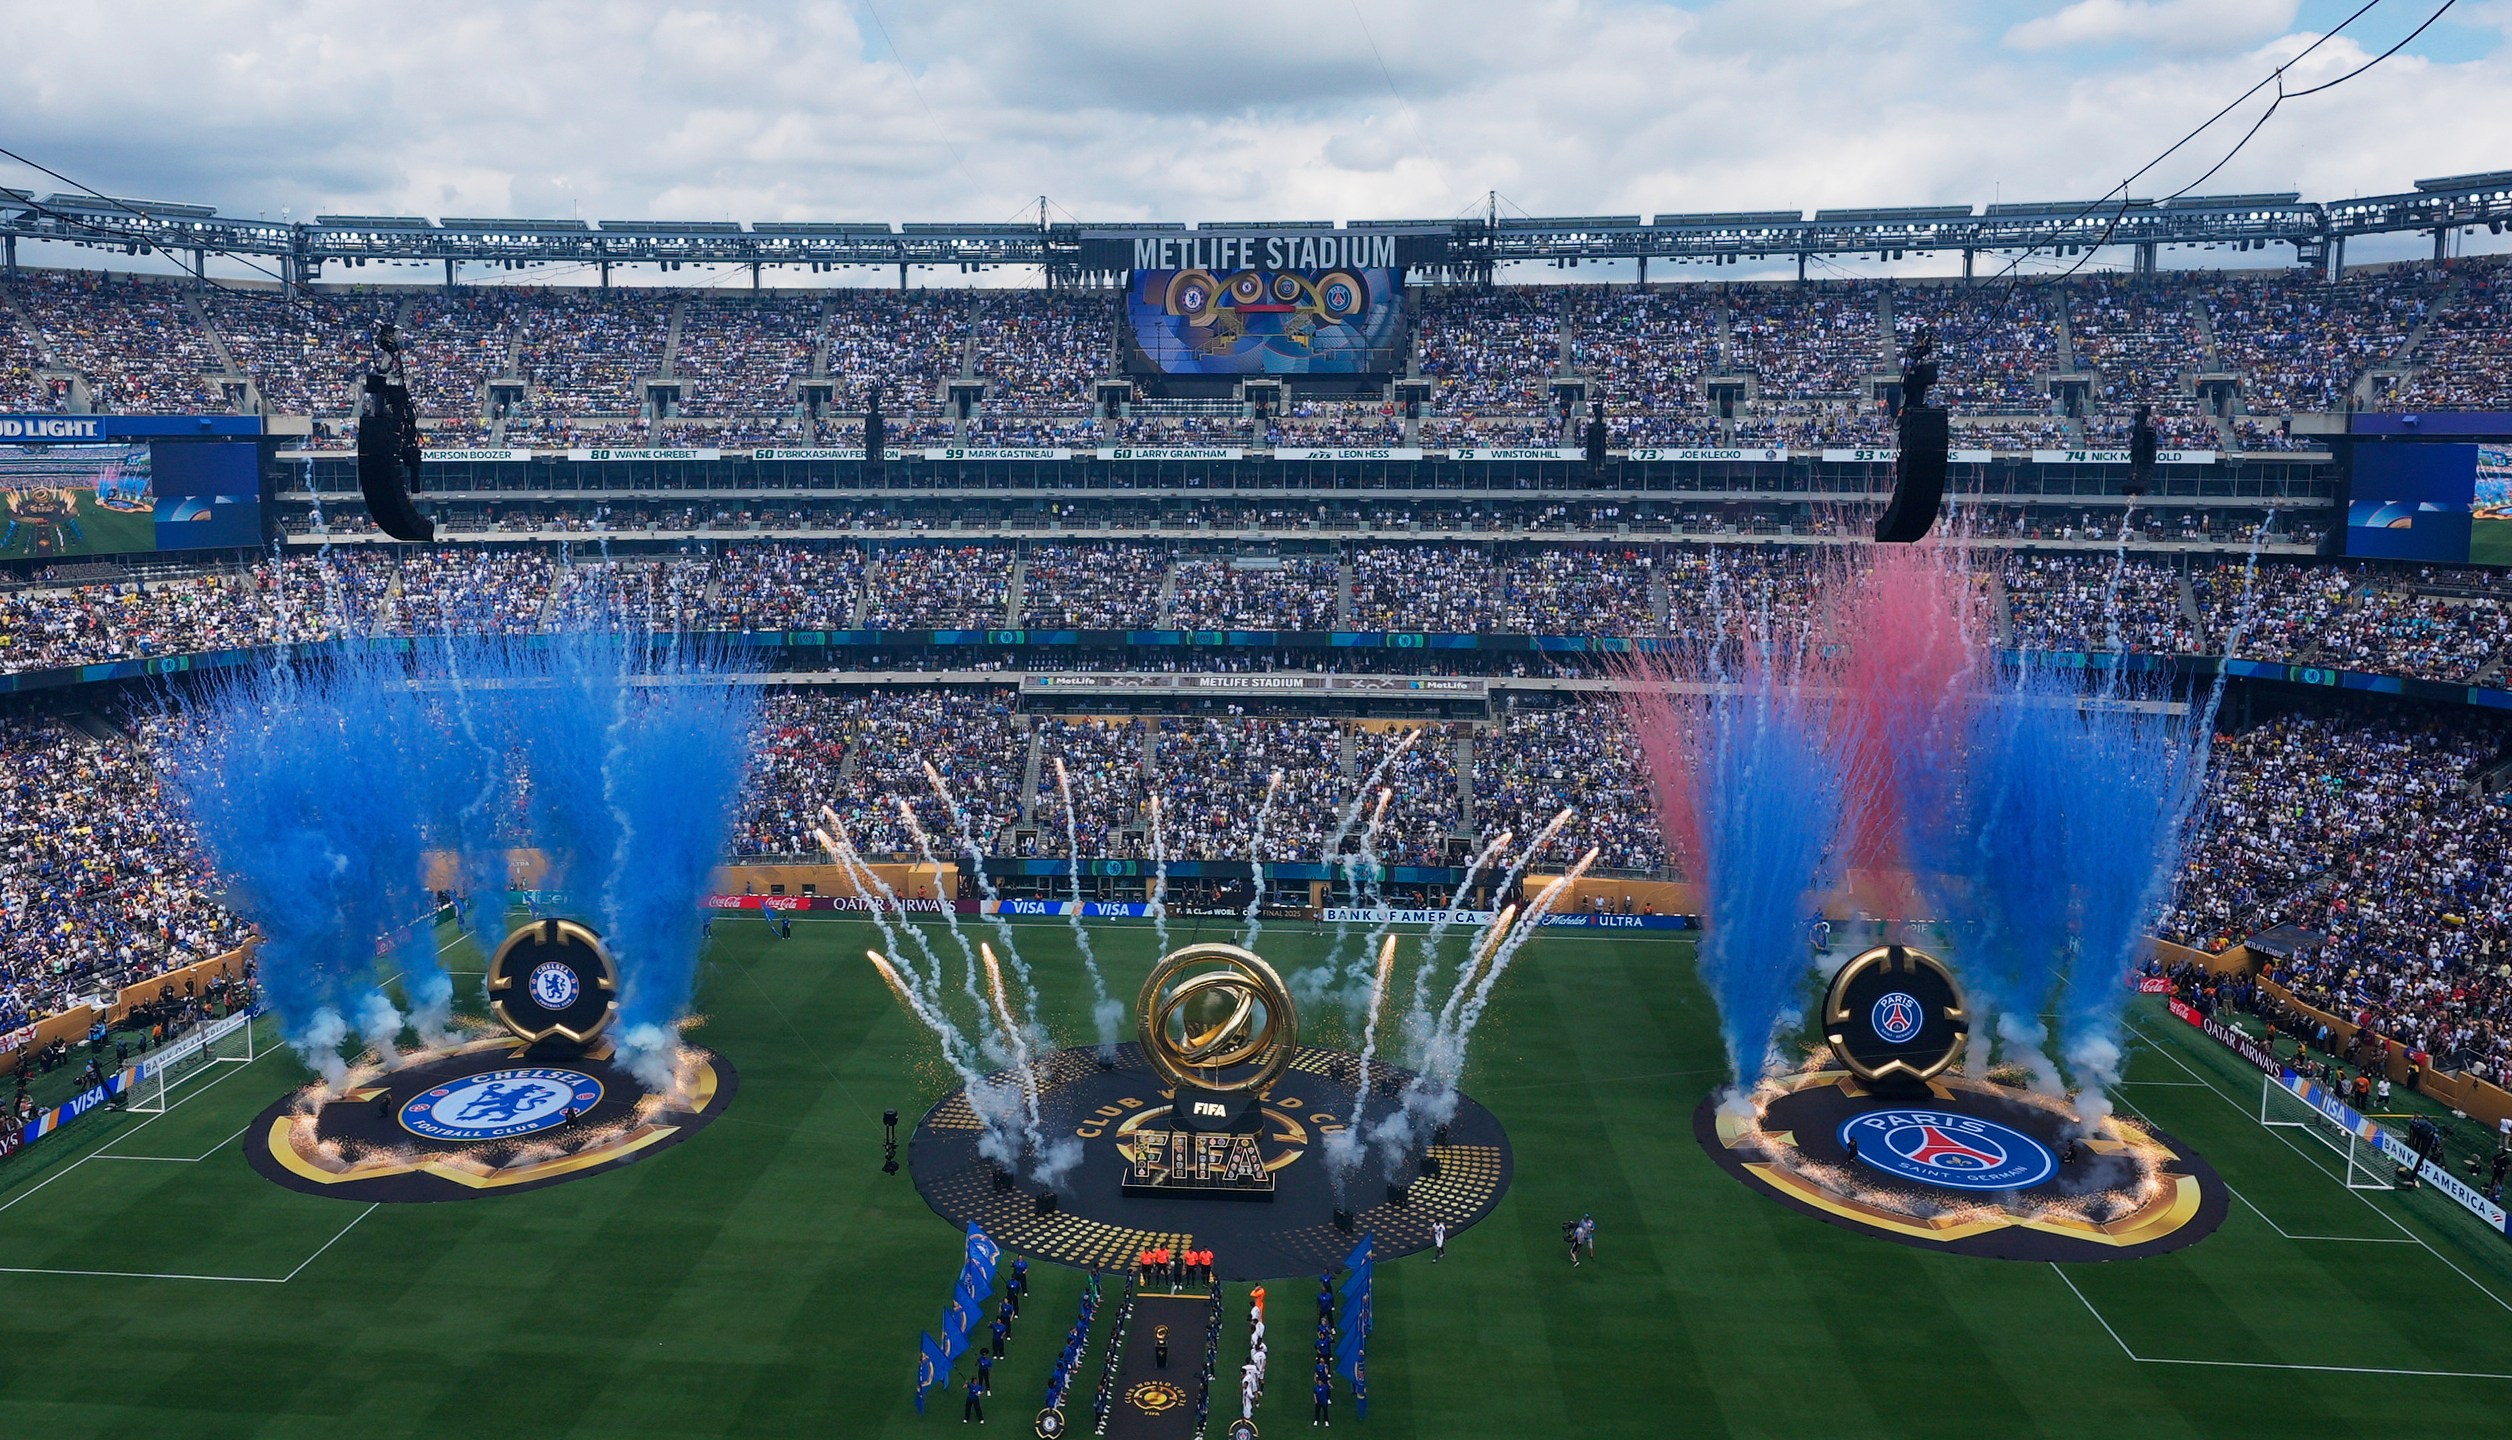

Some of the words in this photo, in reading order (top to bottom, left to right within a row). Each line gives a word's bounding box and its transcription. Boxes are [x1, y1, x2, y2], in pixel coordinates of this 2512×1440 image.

[1134, 236, 1255, 269] METLIFE
[1266, 236, 1396, 269] STADIUM
[25, 419, 97, 437] LIGHT
[421, 451, 468, 460] MERSON
[470, 451, 512, 459] BOOZER
[590, 450, 610, 460] 80
[615, 451, 651, 459] WAYNE
[653, 450, 698, 459] CHREBET
[755, 450, 775, 459] 60
[777, 450, 849, 459] D'BRICKASHAW
[850, 450, 899, 459] FERON
[946, 450, 965, 459] 99
[968, 450, 998, 459] MARK
[1000, 450, 1054, 459] GASTINEAU
[1113, 449, 1132, 459] 60
[1136, 450, 1169, 459] LARRY
[1170, 450, 1227, 459] GRANTHAM
[1338, 450, 1364, 459] LEON
[1366, 450, 1390, 459] HESS
[1457, 450, 1475, 460] 75
[1491, 450, 1539, 459] WINSTON
[1541, 450, 1561, 459] HILL
[1679, 451, 1699, 460] JOE
[1701, 451, 1741, 460] KLECKO
[1854, 450, 1874, 461] 93
[2065, 451, 2087, 462] 74
[2092, 452, 2118, 462] NICK
[1056, 677, 1095, 685] MetLife
[1200, 677, 1249, 687] METLIFE
[1251, 678, 1303, 688] STADIUM
[1427, 681, 1467, 689] MetLife
[833, 897, 885, 911] QATAR
[1014, 902, 1047, 914] VISA
[1098, 904, 1130, 916] VISA
[1328, 909, 1370, 921] BANK
[1541, 914, 1587, 926] Michelob
[1599, 915, 1643, 927] ULTRA
[537, 963, 569, 975] CHELSEA
[1880, 995, 1913, 1008] PARIS
[2203, 1018, 2236, 1049] QATAR
[2239, 1040, 2281, 1078] AIRWAYS
[471, 1070, 589, 1087] CHELSEA
[69, 1085, 104, 1116] VISA
[1193, 1102, 1227, 1118] FIFA
[1076, 1097, 1144, 1138] CLUB
[1863, 1113, 1987, 1133] PARIS
[412, 1119, 482, 1137] FOOTBALL
[492, 1122, 540, 1136] CLUB
[1133, 1130, 1269, 1181] FIFA
[1898, 1162, 1949, 1178] SAINT
[1966, 1165, 2028, 1182] GERMAIN
[2384, 1138, 2414, 1166] BANK
[2432, 1171, 2486, 1216] AMERICA
